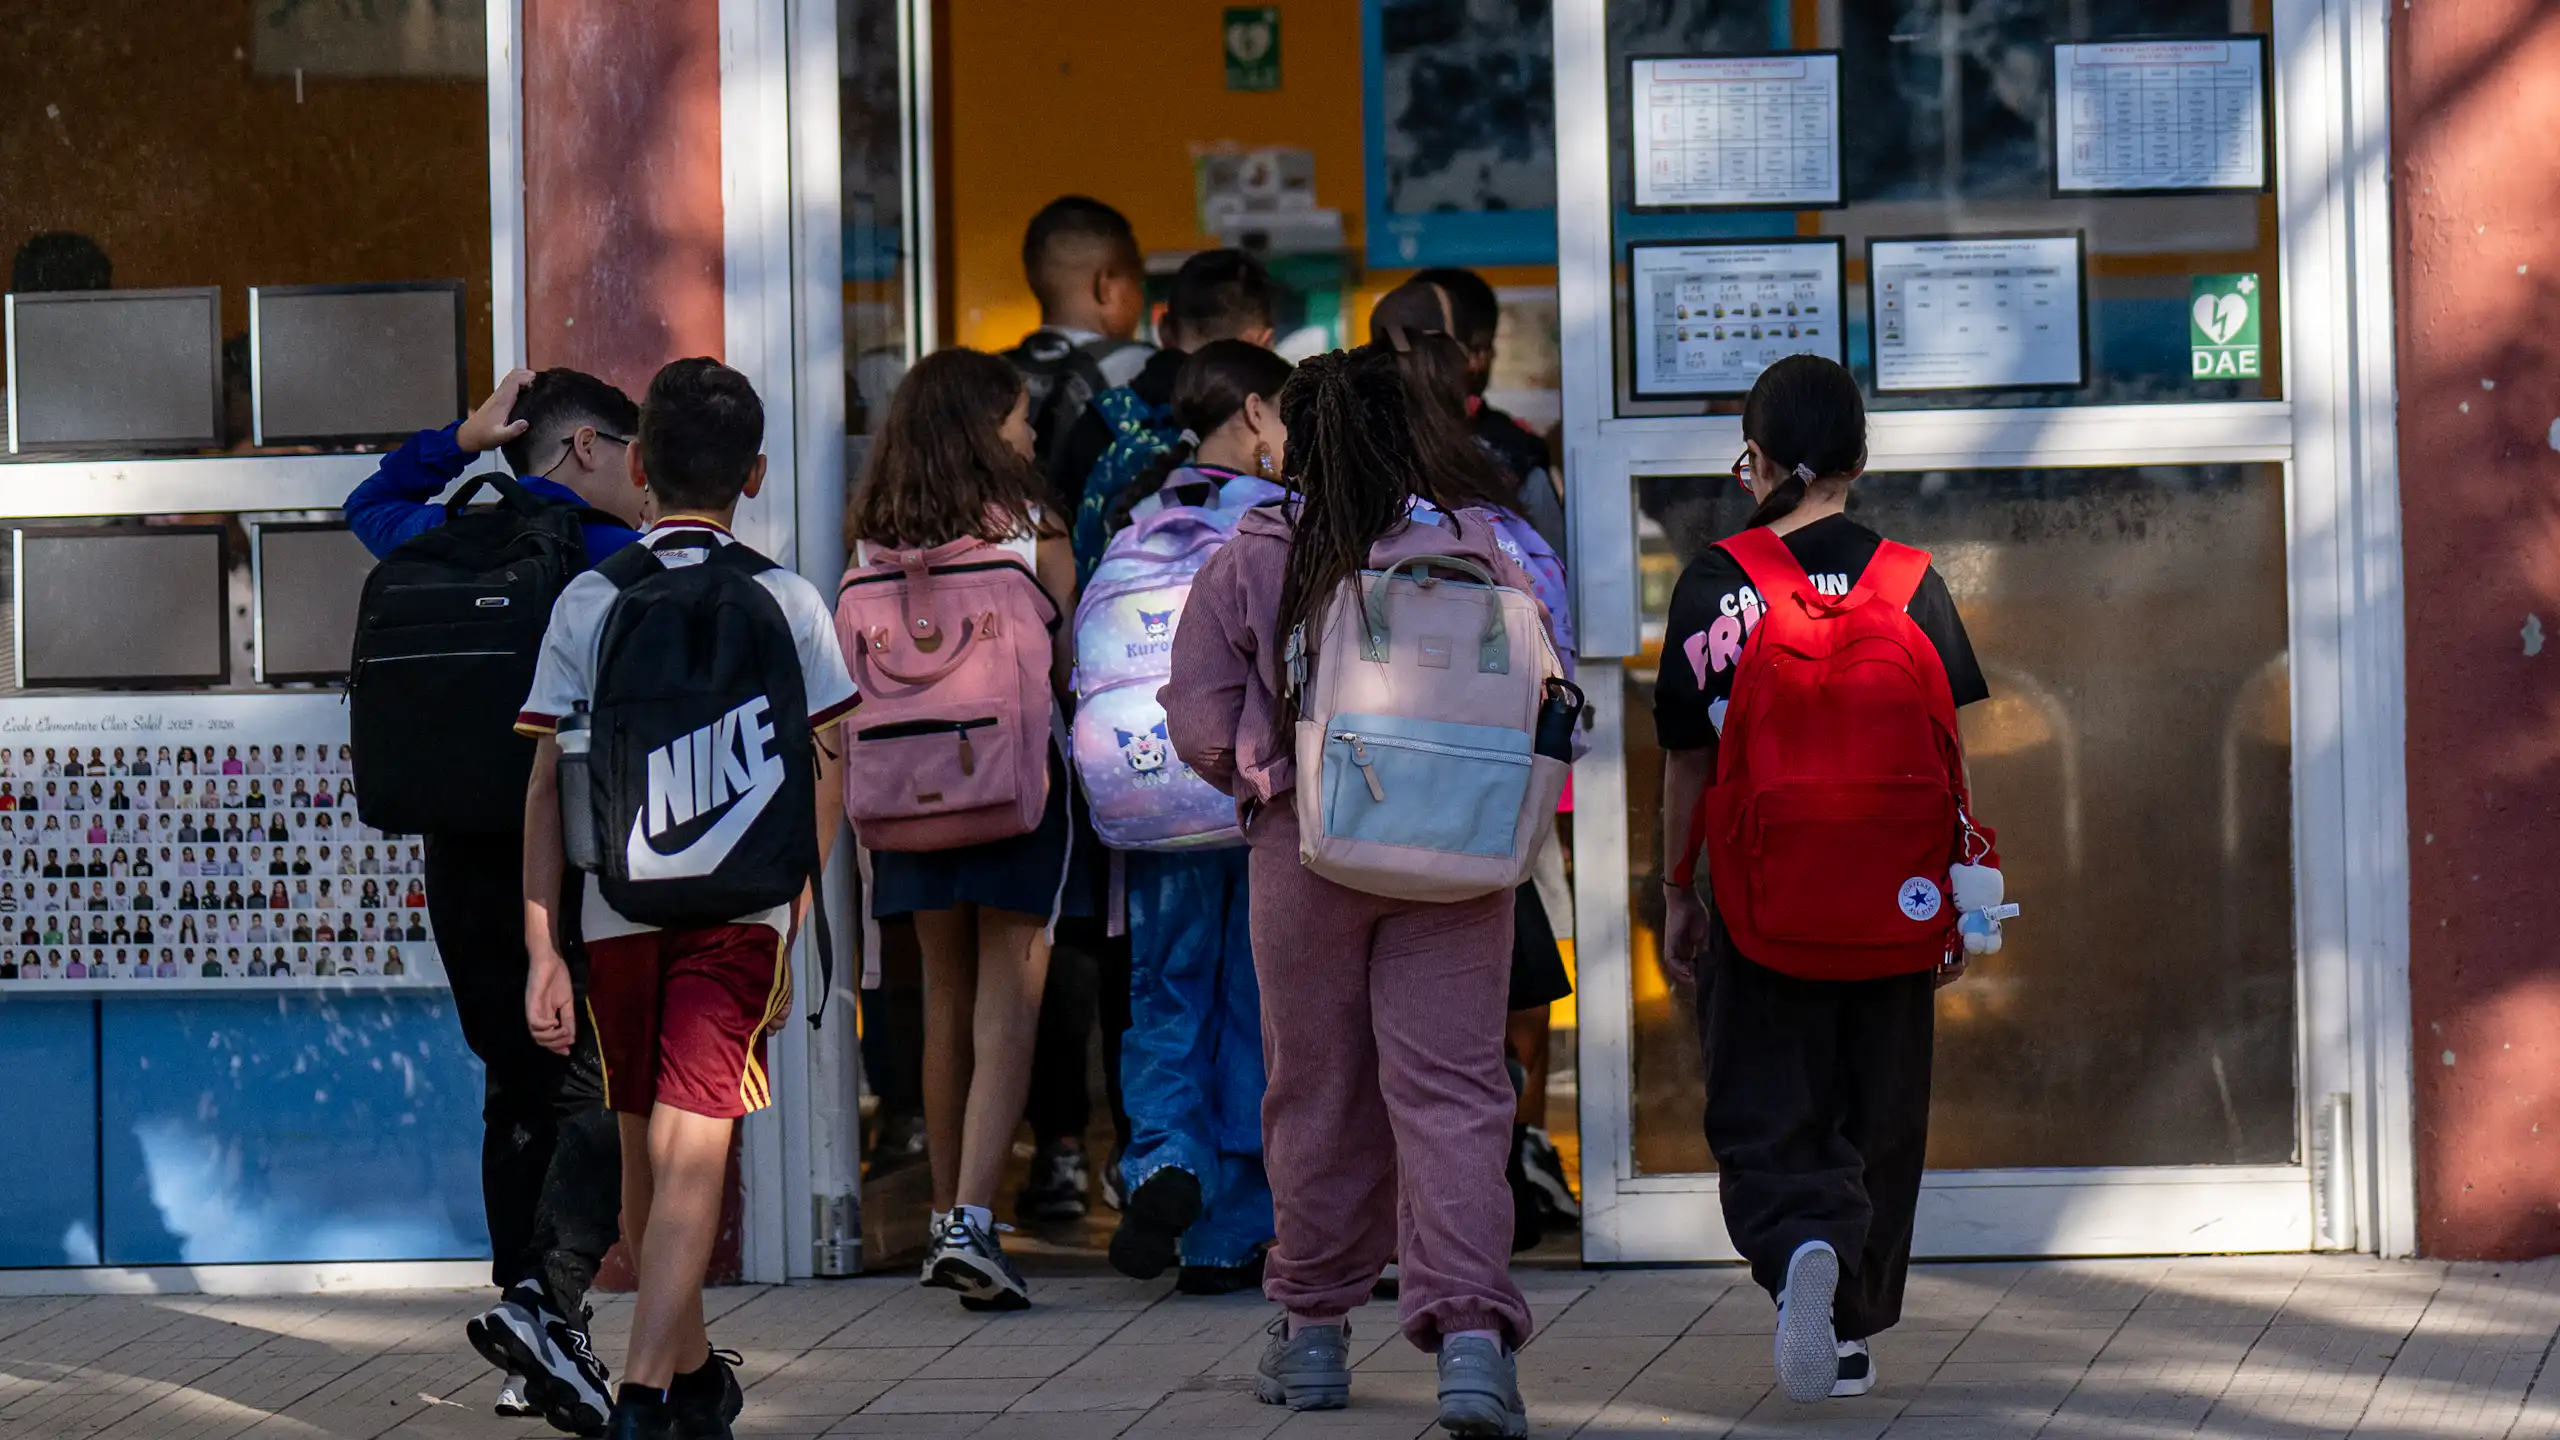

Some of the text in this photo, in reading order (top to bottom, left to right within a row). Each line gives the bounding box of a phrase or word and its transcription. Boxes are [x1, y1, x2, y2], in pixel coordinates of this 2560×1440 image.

[2192, 350, 2257, 375] DAE
[1125, 642, 1169, 658] Kuro
[101, 712, 128, 731] Clair
[131, 713, 162, 732] Soleil
[648, 695, 785, 838] NIKE
